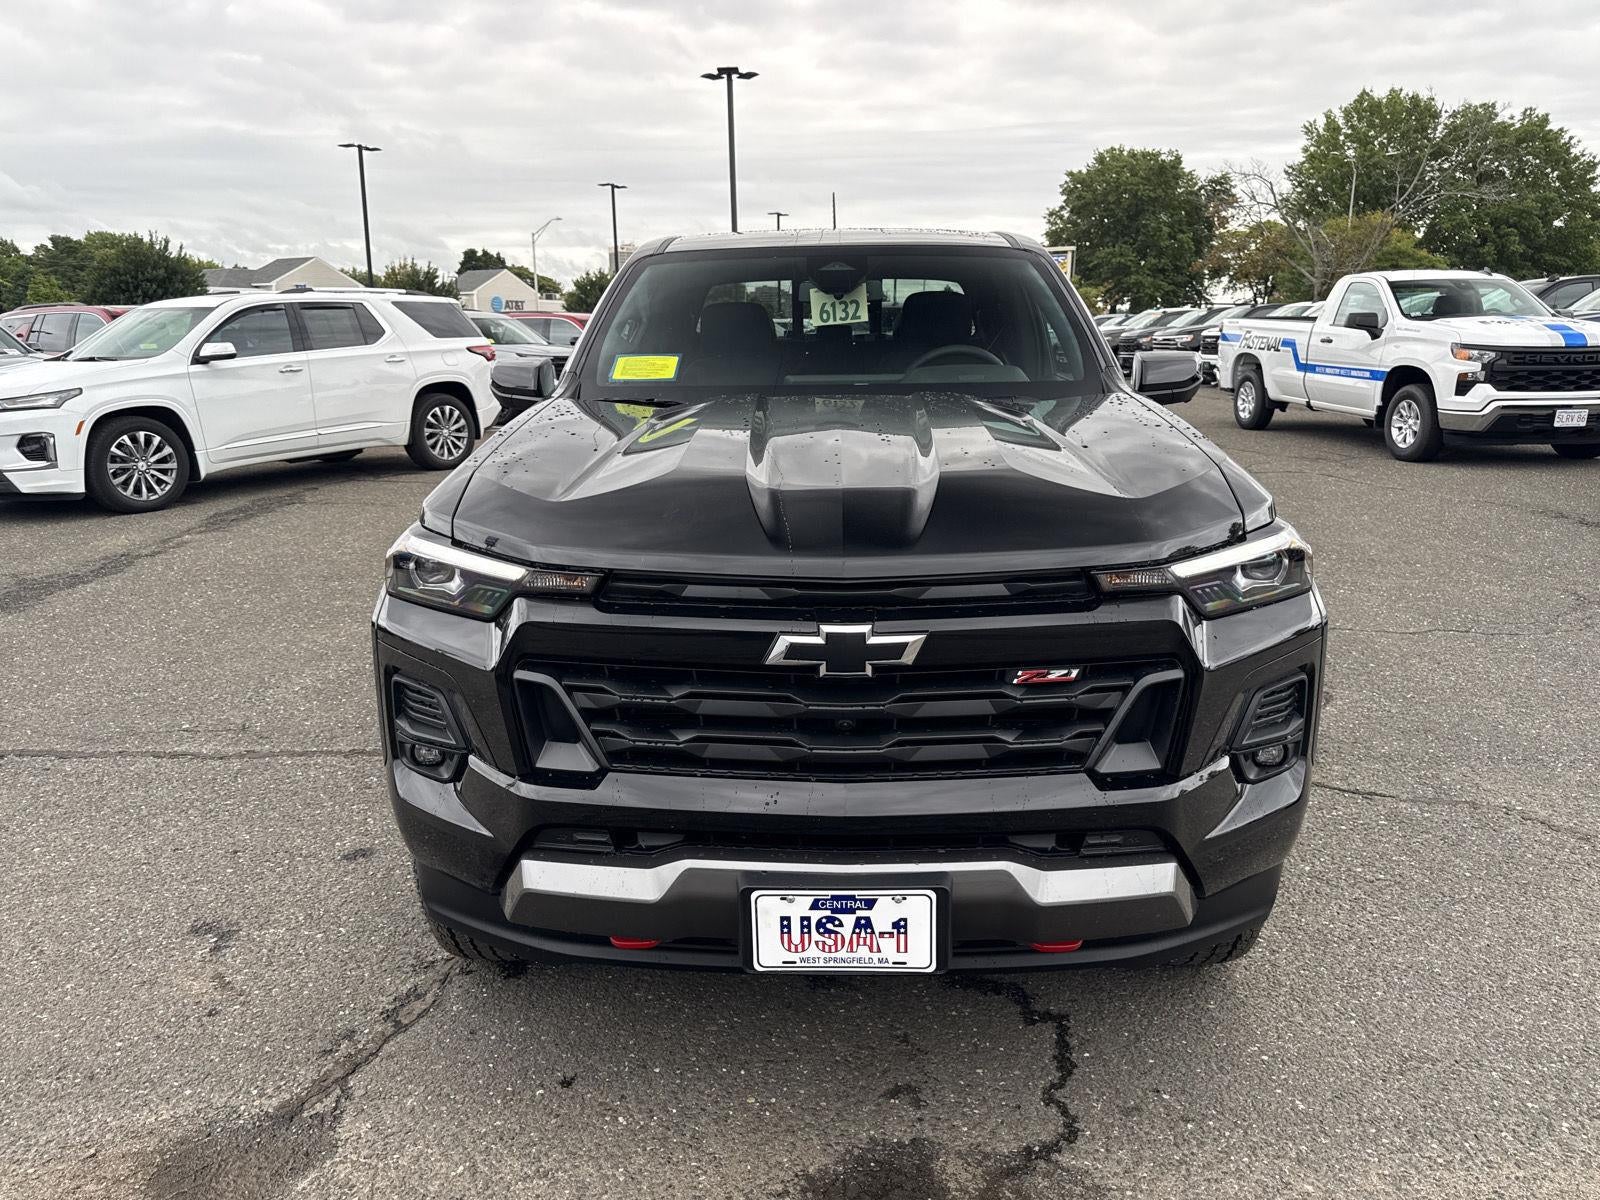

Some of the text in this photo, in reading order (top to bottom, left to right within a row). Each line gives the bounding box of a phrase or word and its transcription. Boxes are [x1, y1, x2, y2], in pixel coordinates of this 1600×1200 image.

[504, 300, 525, 311] AT&T
[819, 299, 861, 323] 6132
[1239, 330, 1281, 352] FASTENAL
[1511, 353, 1600, 363] CHEVRO
[1576, 414, 1586, 423] 86
[818, 900, 868, 909] CENTRAL
[779, 915, 908, 953] USA-1
[823, 957, 876, 965] SPRINGFIELD,
[877, 957, 889, 965] MA
